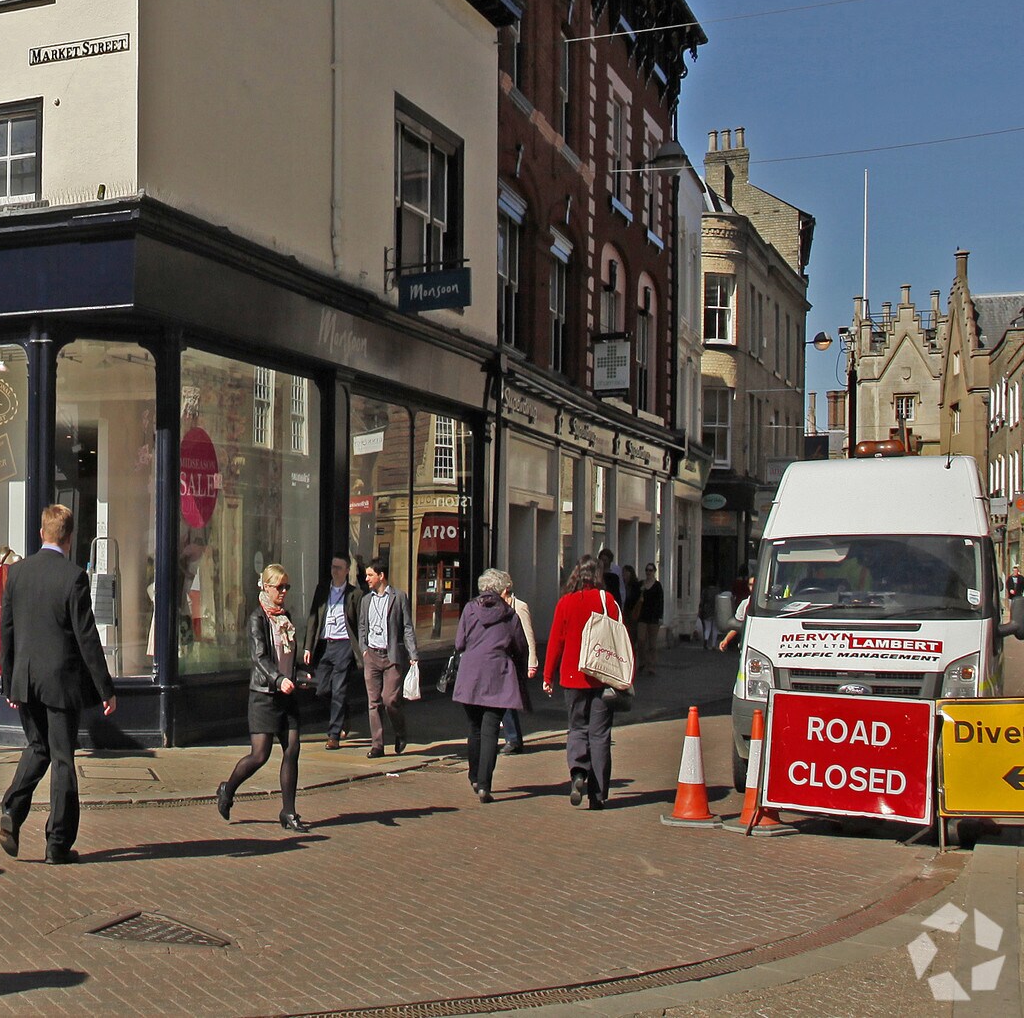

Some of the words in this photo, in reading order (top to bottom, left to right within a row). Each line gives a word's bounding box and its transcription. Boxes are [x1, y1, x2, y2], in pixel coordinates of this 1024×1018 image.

[32, 46, 80, 63] MARKET
[82, 39, 126, 55] STREET
[410, 284, 459, 301] Monsoon
[318, 306, 367, 359] Monsoon
[180, 472, 216, 497] SALE
[781, 633, 853, 642] MERVYN
[852, 638, 938, 651] LAMBERT
[837, 652, 940, 662] MANAGEMENT
[807, 716, 891, 747] ROAD
[954, 720, 1024, 744] Dive
[788, 760, 907, 795] CLOSED
